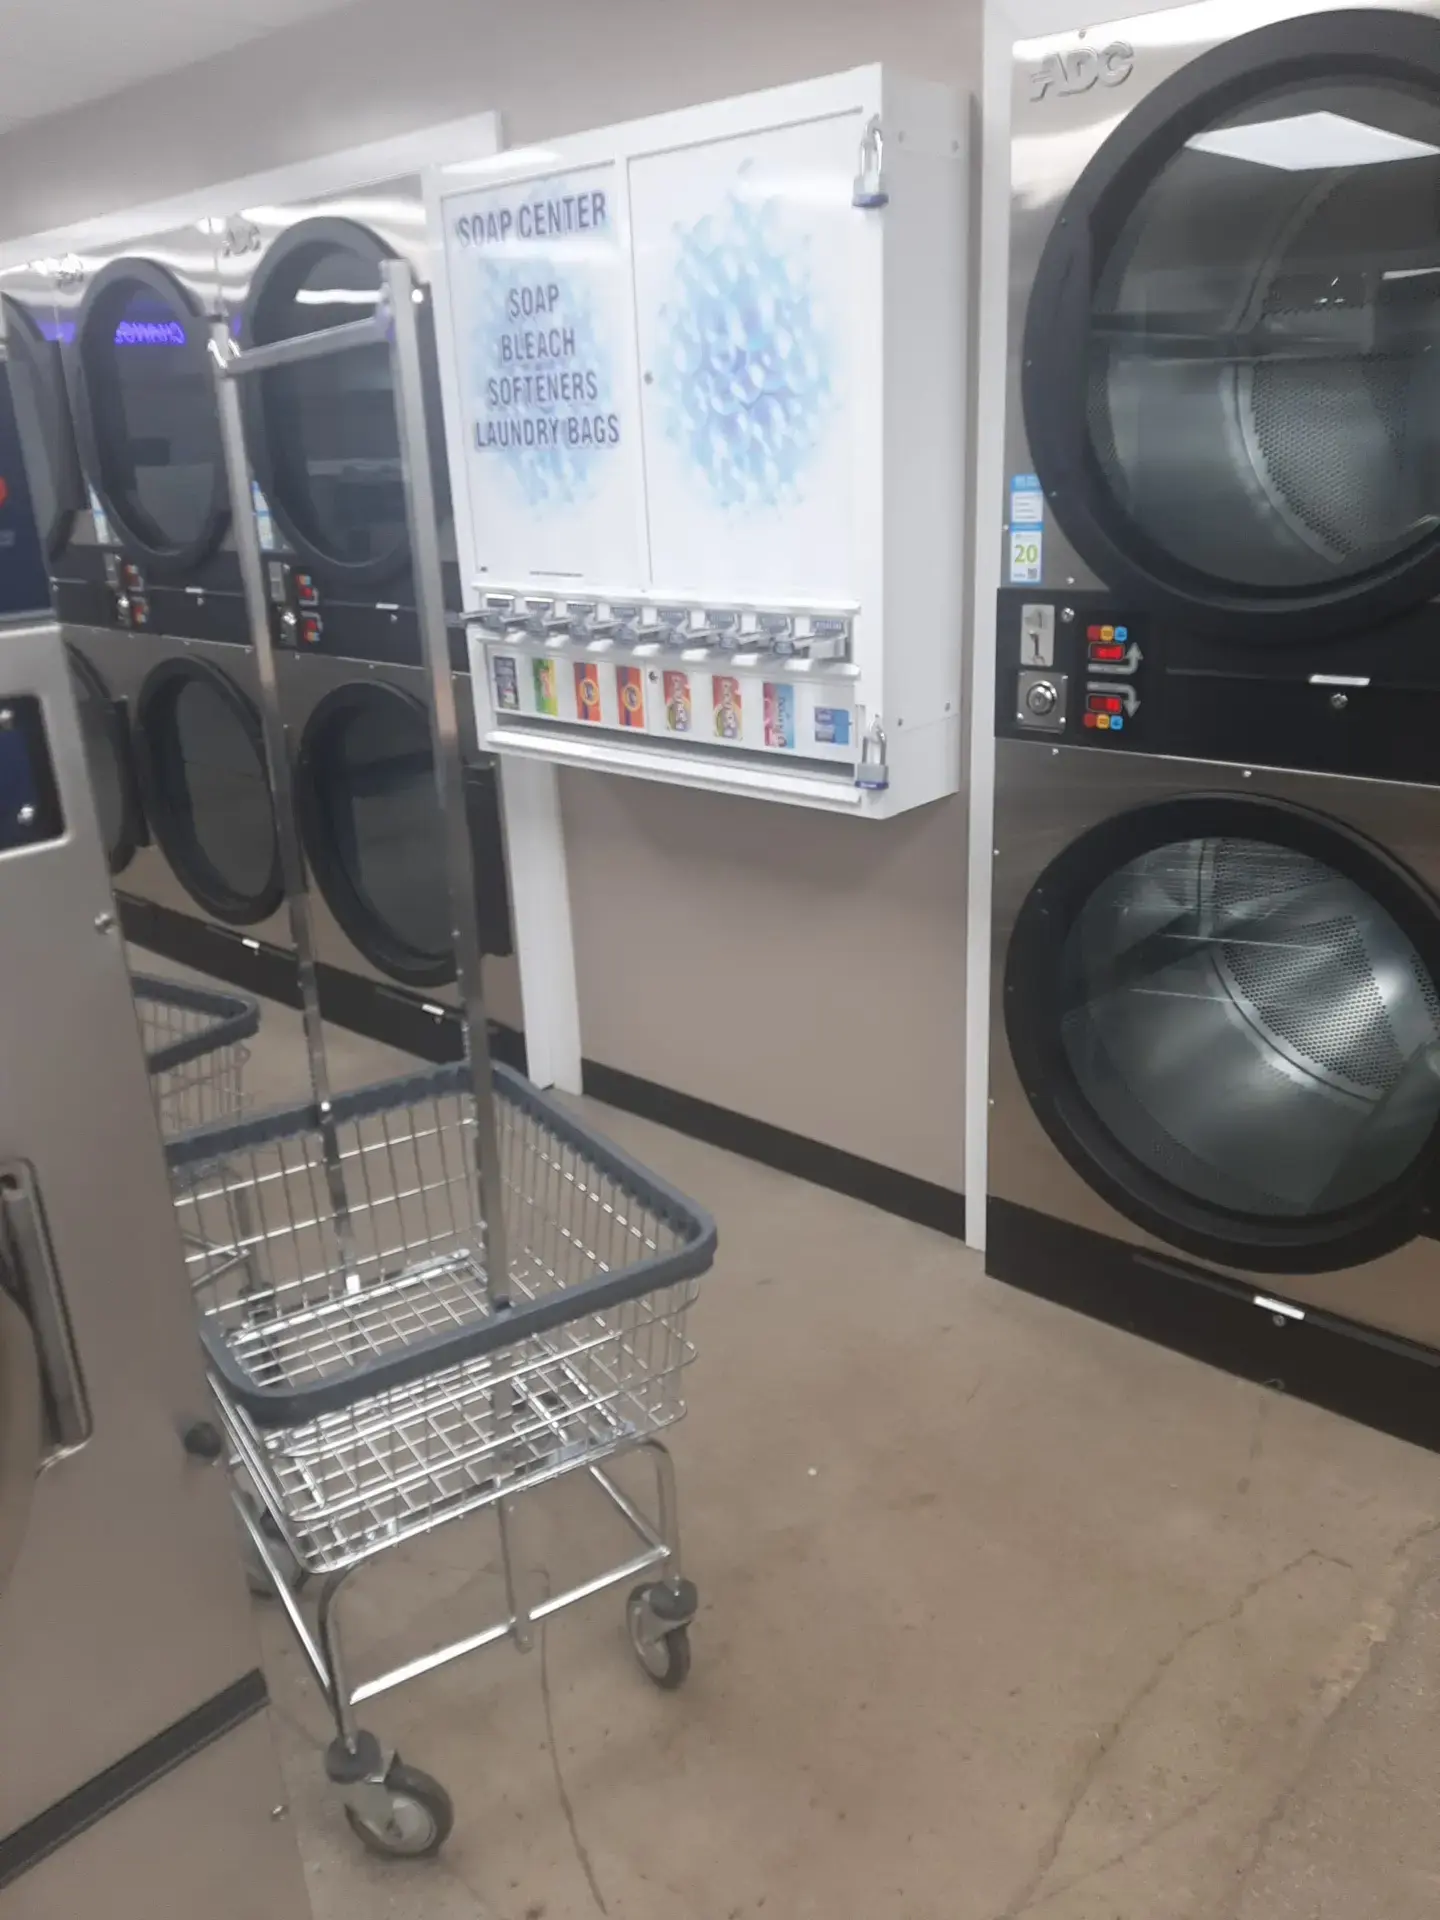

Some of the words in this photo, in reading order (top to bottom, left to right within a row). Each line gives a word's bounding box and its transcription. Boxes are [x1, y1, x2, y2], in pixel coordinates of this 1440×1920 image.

[1029, 41, 1134, 102] ADC
[457, 208, 512, 247] SOAP
[518, 191, 606, 238] CENTER
[508, 283, 560, 319] SOAP
[501, 327, 576, 362] BLEACH
[488, 370, 598, 406] SOFTENERS
[475, 418, 560, 447] LAUNDRY
[567, 413, 620, 445] BAGS
[1014, 544, 1038, 564] 20
